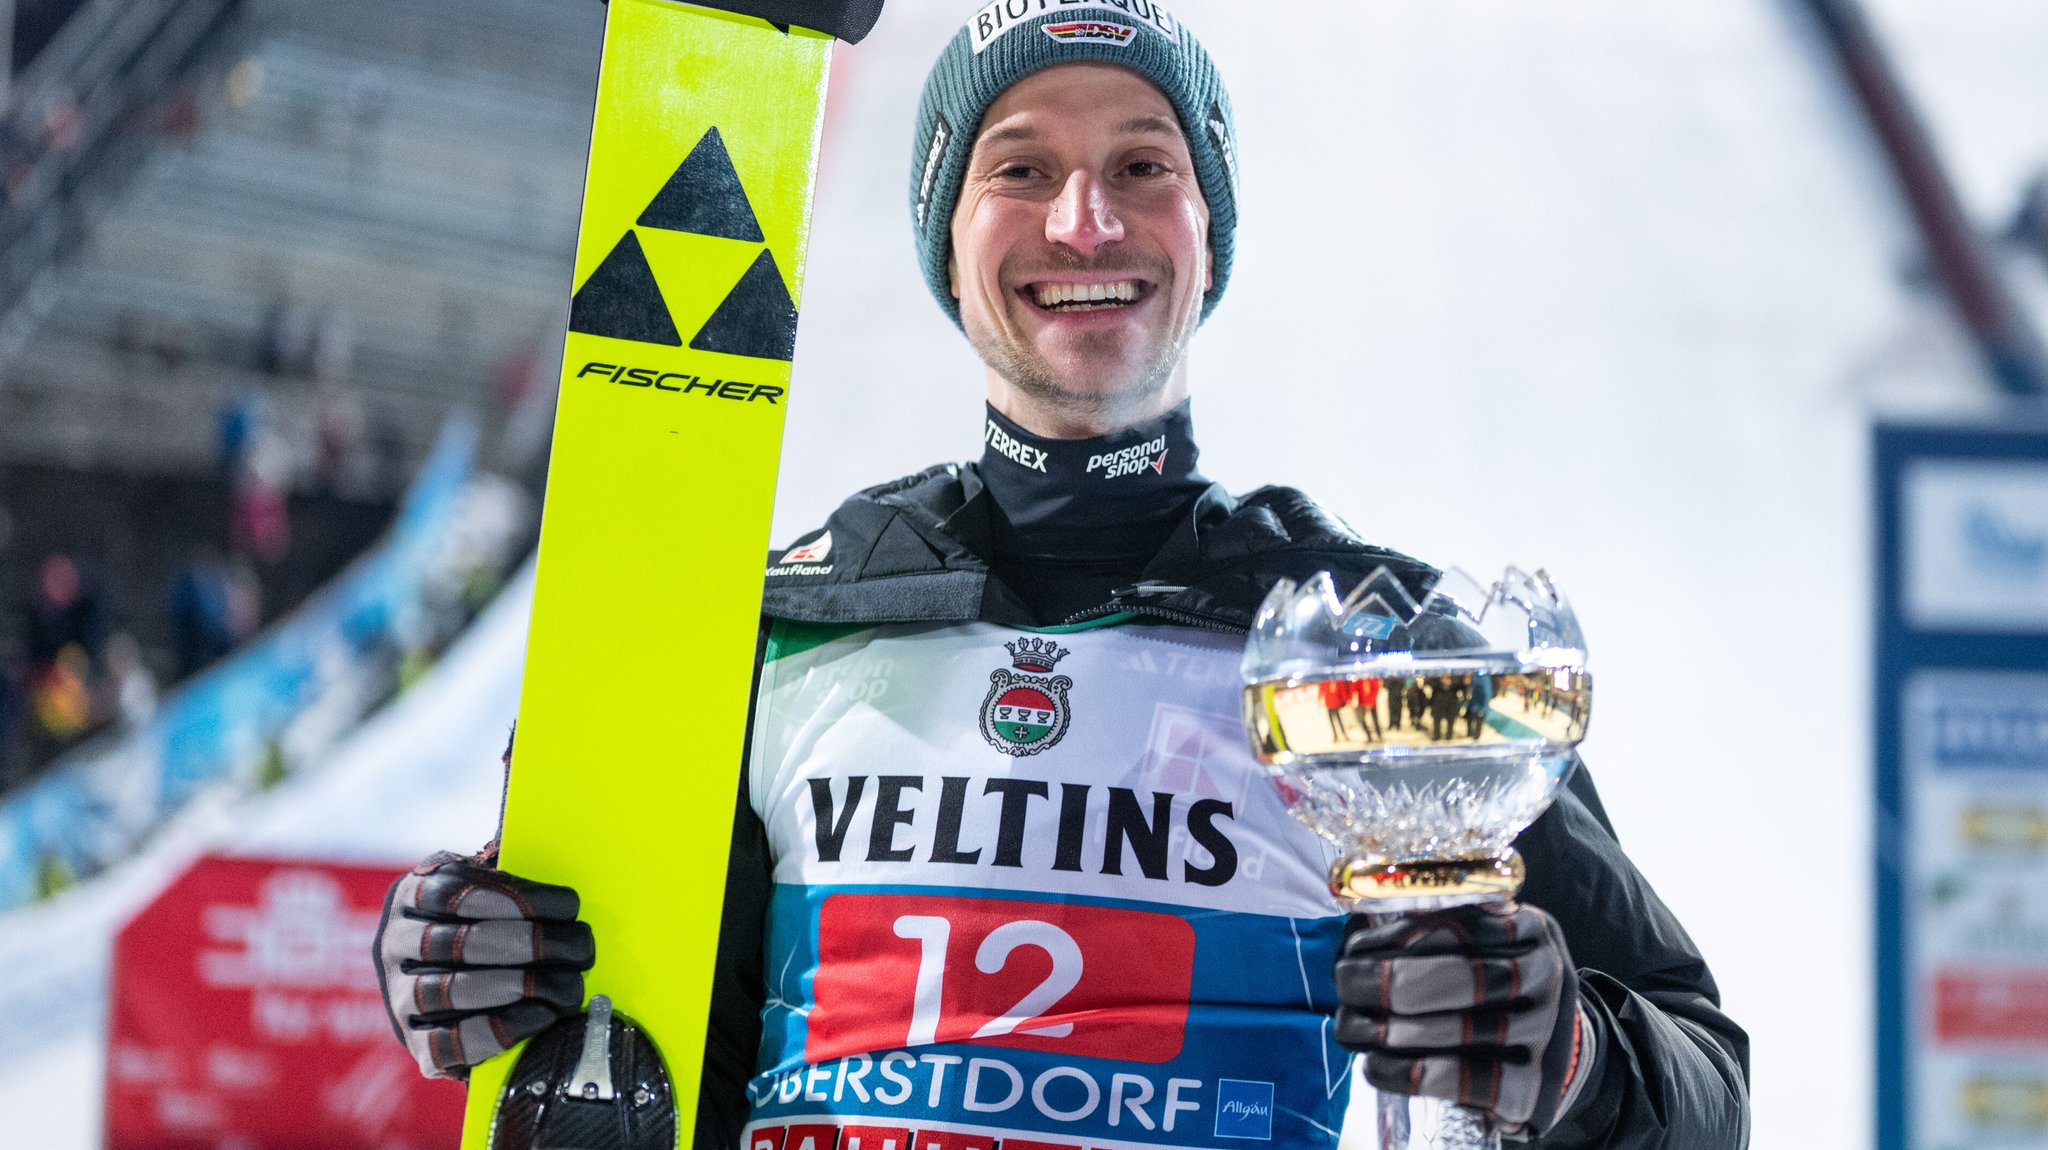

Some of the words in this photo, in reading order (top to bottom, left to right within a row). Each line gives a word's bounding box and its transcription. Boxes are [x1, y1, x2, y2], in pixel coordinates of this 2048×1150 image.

[977, 0, 1173, 42] BIOUE
[1087, 23, 1132, 42] DSV
[576, 362, 784, 405] FISCHER
[984, 419, 1049, 474] TERREX
[1086, 434, 1166, 473] personal
[1104, 455, 1150, 479] shop
[807, 775, 1239, 887] VELTINS
[892, 914, 1084, 1048] 12
[747, 1050, 1203, 1133] OBERSTDORF
[1222, 1100, 1269, 1121] Allgäu
